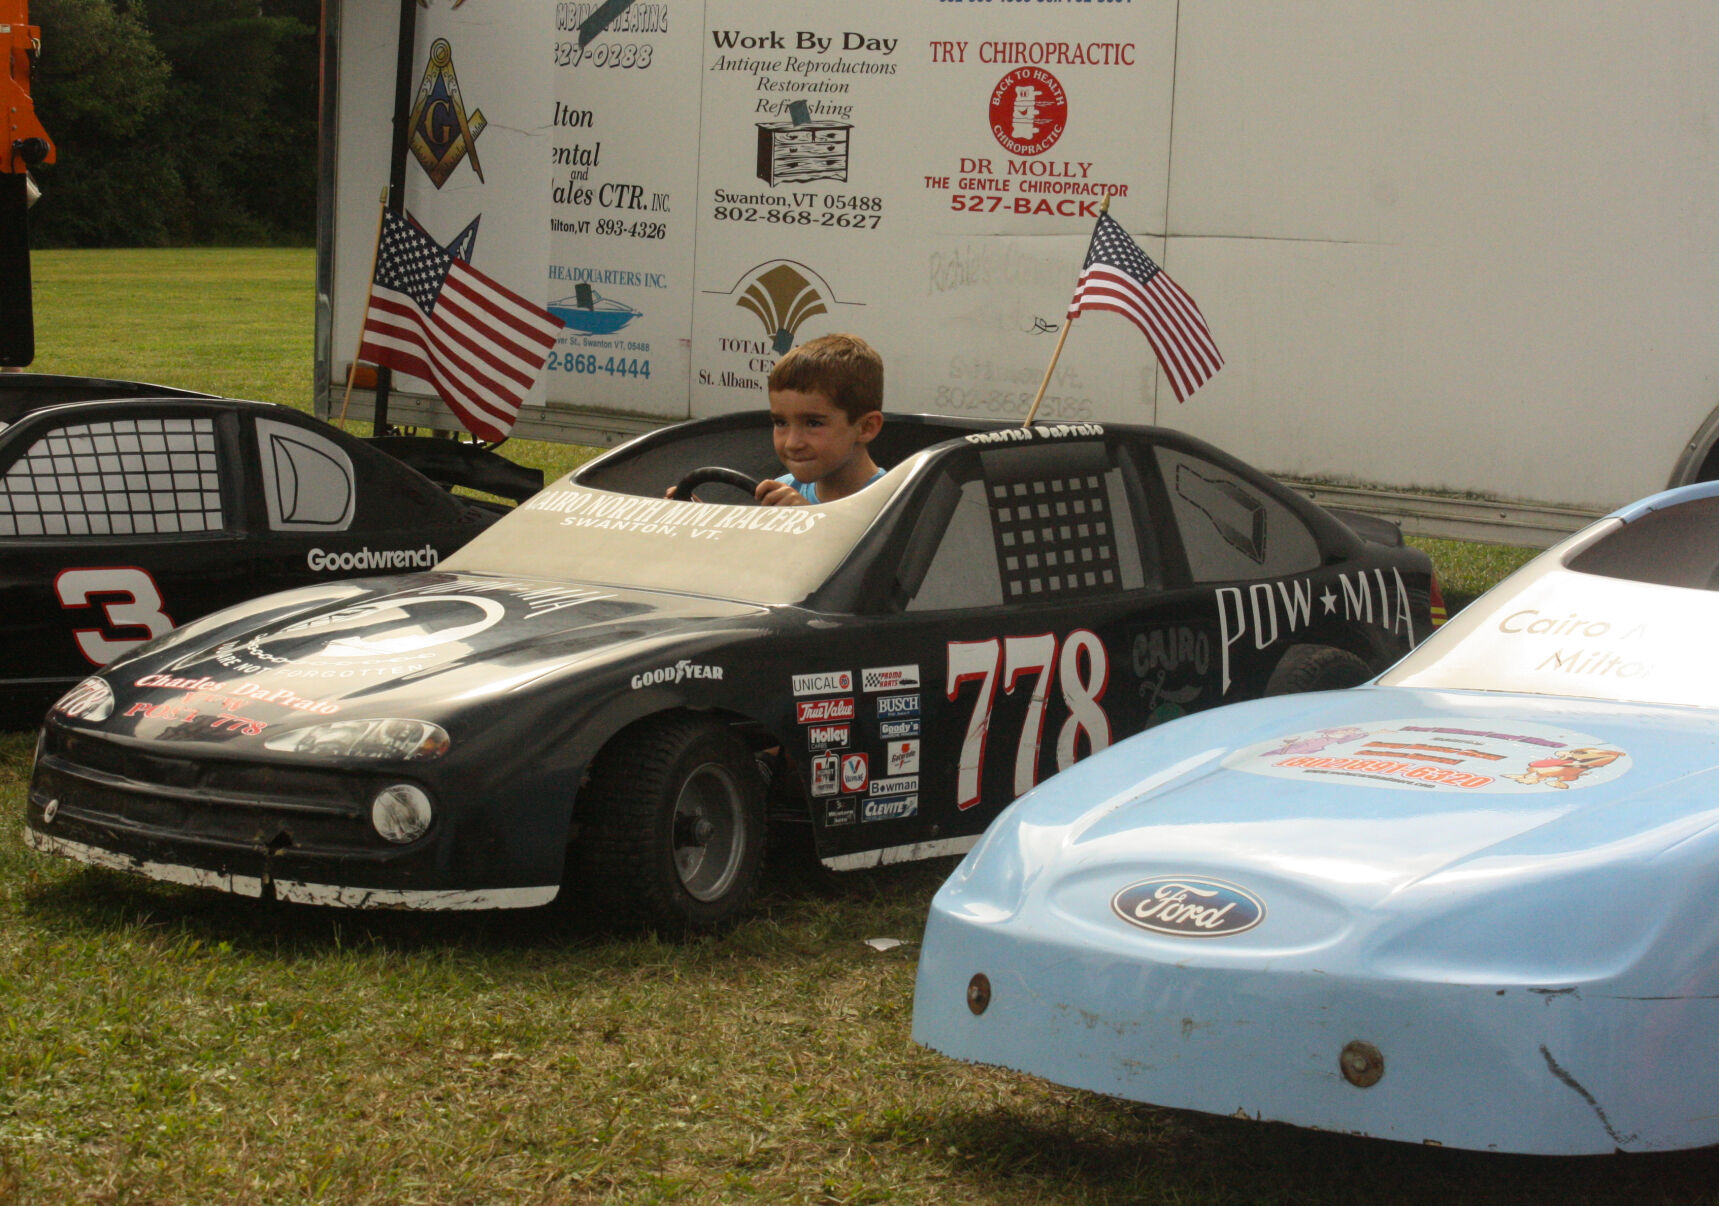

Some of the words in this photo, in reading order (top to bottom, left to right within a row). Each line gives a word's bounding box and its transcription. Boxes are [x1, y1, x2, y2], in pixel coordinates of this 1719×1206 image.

[712, 30, 785, 50] Work
[795, 31, 832, 54] By
[842, 32, 898, 55] Day
[930, 41, 968, 63] TRY
[979, 41, 1136, 66] CHIROPRACTIC
[711, 55, 782, 76] Antique
[784, 57, 897, 77] Reproductions
[756, 76, 849, 94] Restoration
[991, 76, 1015, 107] BACK
[1015, 69, 1031, 80] TO
[1032, 70, 1065, 107] HEALTH
[993, 124, 1063, 154] CHIROPRACTIC
[570, 167, 589, 182] and
[959, 157, 993, 175] DR
[1007, 160, 1093, 179] MOLLY
[598, 182, 648, 211] CTR.
[651, 192, 671, 213] INC.
[924, 176, 950, 190] THE
[958, 177, 1010, 192] GENTLE
[1019, 180, 1129, 198] CHIROPRACTOR
[823, 193, 882, 212] 05488
[950, 194, 1099, 219] 527-BACK
[595, 218, 667, 240] 893-4326
[714, 206, 882, 230] 802-868-2627
[548, 264, 642, 287] HEADQUARTERS
[644, 272, 667, 289] INC.
[583, 337, 612, 349] Swanton
[719, 337, 771, 356] TOTAL
[547, 350, 650, 380] 2-868-4444
[698, 368, 714, 386] St.
[718, 370, 763, 392] Albans,
[524, 490, 593, 513] CAIRO
[579, 493, 671, 523] NORTH
[658, 501, 723, 528] MINI
[720, 504, 826, 535] RACERS
[560, 516, 679, 538] SWANTON,
[689, 527, 723, 541] VT.
[307, 544, 439, 572] Goodwrench
[53, 565, 177, 666] 3
[1498, 609, 1612, 638] Cairo
[1214, 577, 1312, 697] POW
[1338, 567, 1416, 650] MIA
[233, 662, 273, 675] NOT
[274, 663, 424, 679] FORGOTTEN
[631, 660, 723, 690] GOODYEAR
[134, 673, 228, 692] Charles
[228, 681, 342, 716] DaPrato
[793, 676, 839, 693] UNICAL
[878, 696, 919, 713] BUSCH
[210, 712, 268, 737] 778
[881, 721, 919, 735] Goody's
[946, 628, 1114, 812] 778
[810, 727, 848, 746] Holley
[865, 801, 905, 817] CLEVITE
[1135, 883, 1237, 929] Ford
